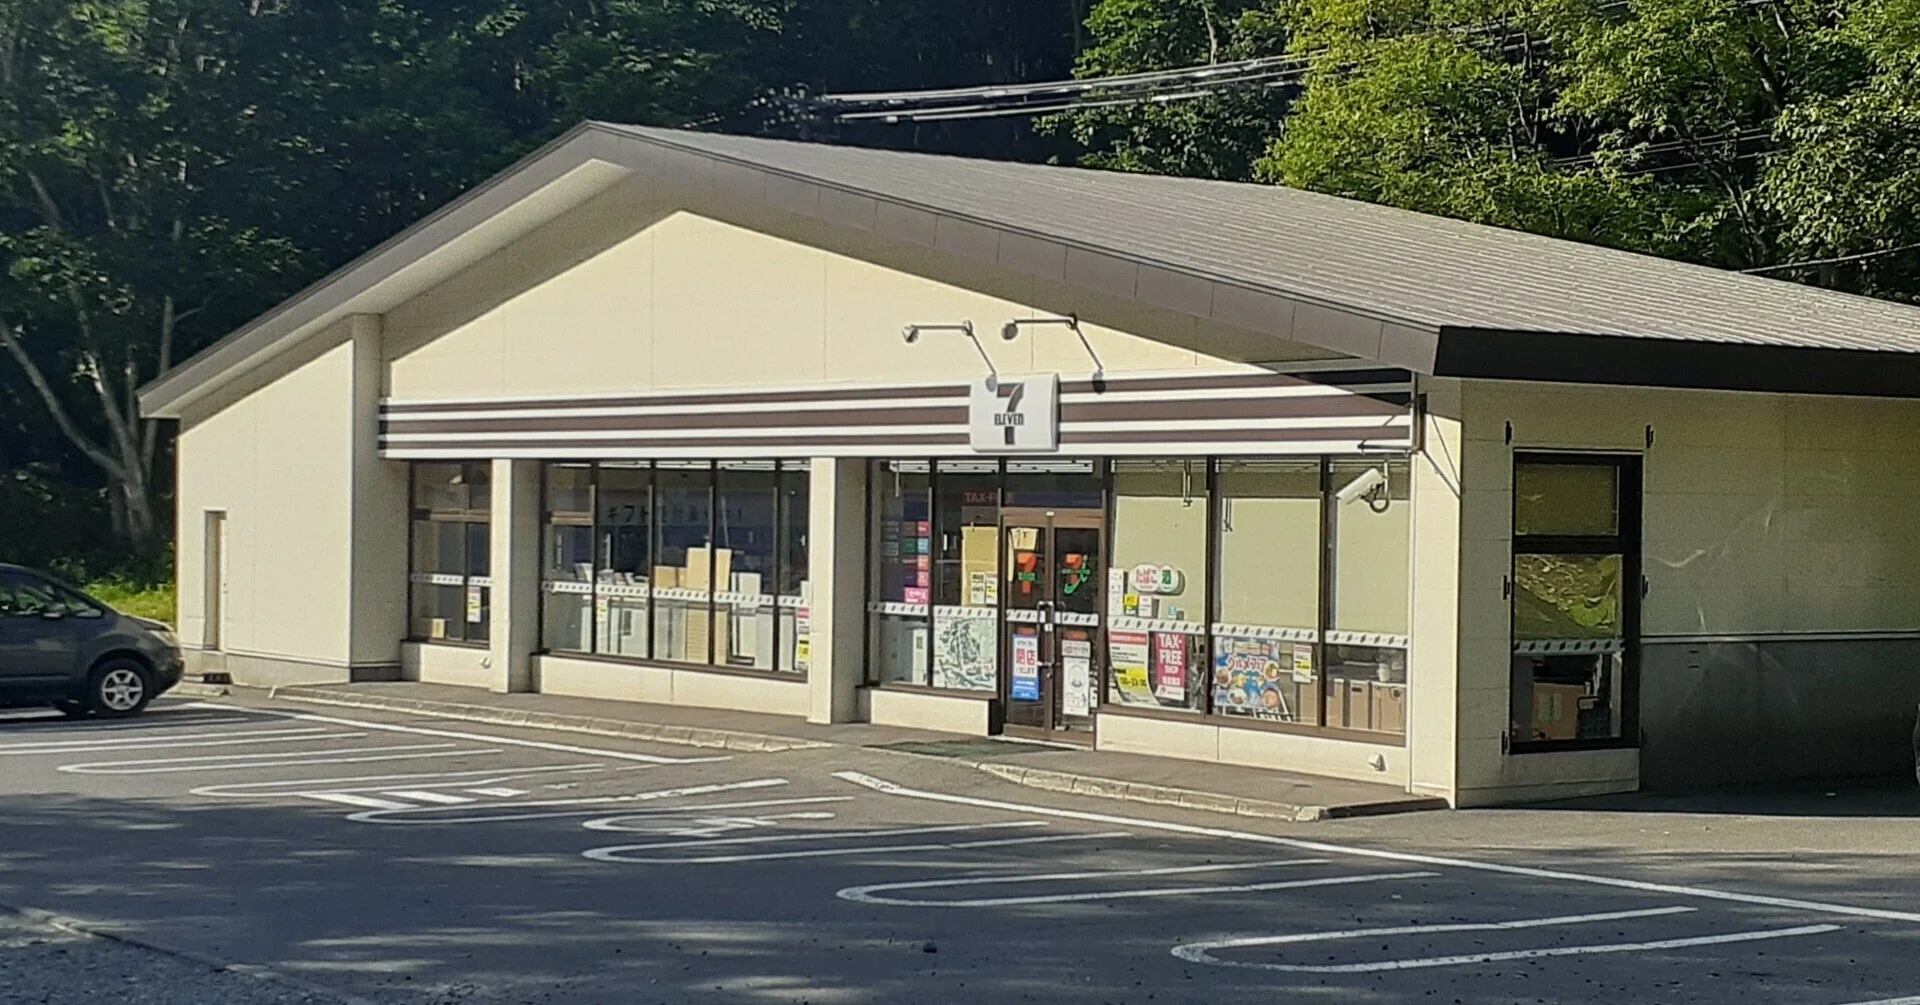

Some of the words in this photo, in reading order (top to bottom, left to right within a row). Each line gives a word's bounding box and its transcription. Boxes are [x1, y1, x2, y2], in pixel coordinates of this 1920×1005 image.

[996, 383, 1025, 445] 7
[1016, 648, 1036, 665] 閉店
[1159, 649, 1183, 665] FREE
